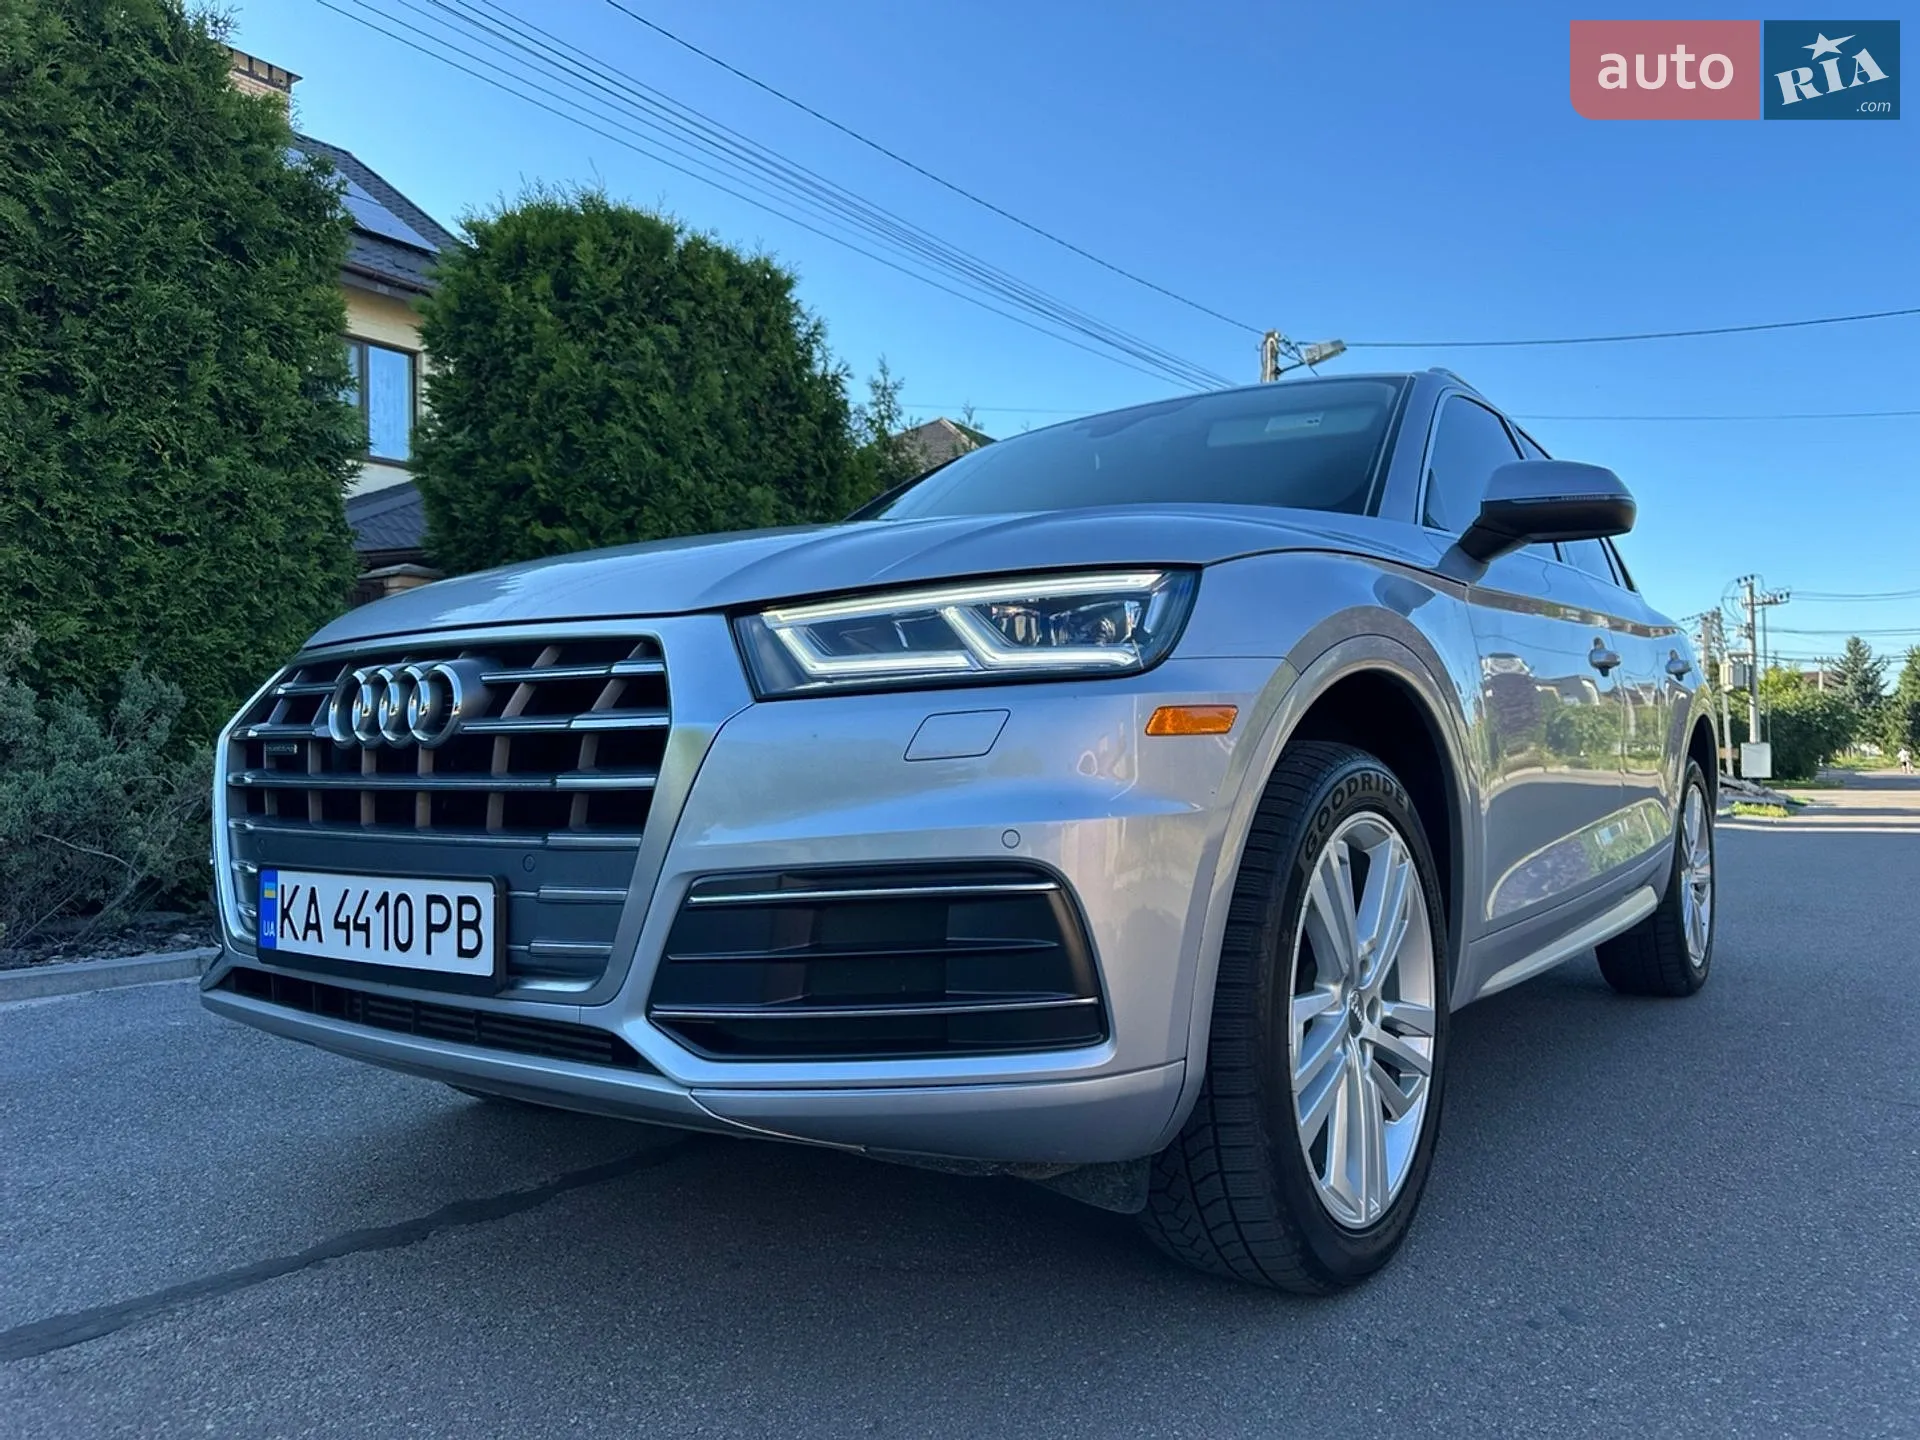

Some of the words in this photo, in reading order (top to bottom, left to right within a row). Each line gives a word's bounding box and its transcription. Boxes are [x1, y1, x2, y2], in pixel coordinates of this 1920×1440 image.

[1305, 772, 1406, 861] GOODRIDE
[262, 919, 276, 938] UA
[280, 884, 323, 943] KA
[333, 888, 414, 953] 4410
[426, 894, 483, 959] PB
